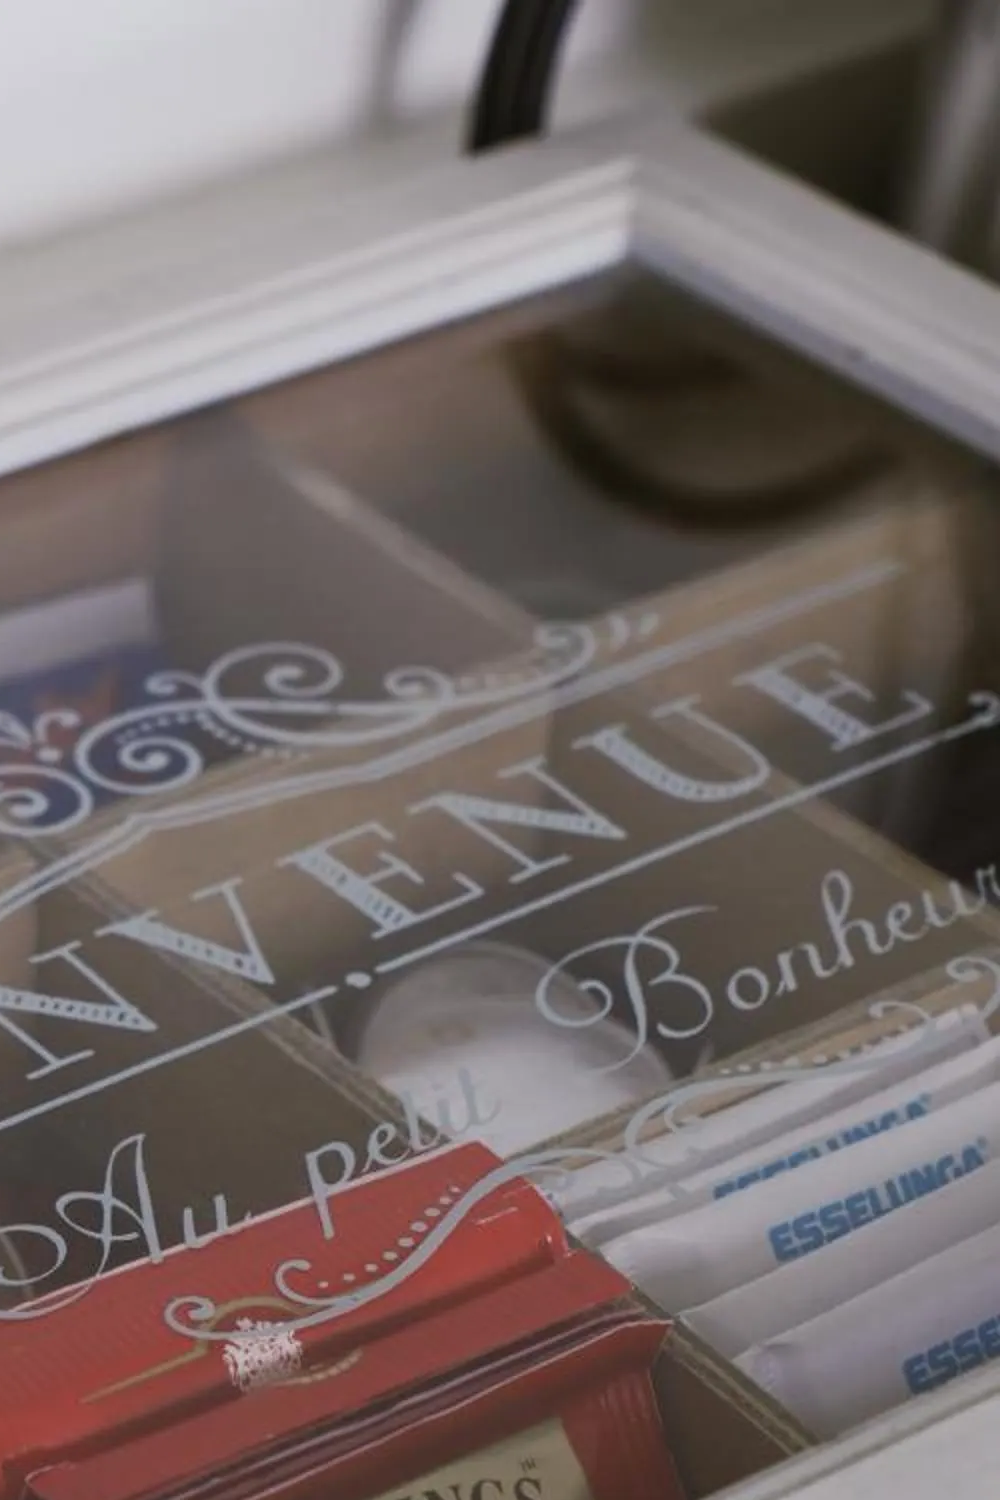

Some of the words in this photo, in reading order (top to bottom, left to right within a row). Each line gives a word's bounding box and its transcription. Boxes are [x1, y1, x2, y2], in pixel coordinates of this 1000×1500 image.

[304, 1068, 501, 1238] petit
[535, 863, 1000, 1075] Bonheur
[903, 1314, 1000, 1395] ESSE
